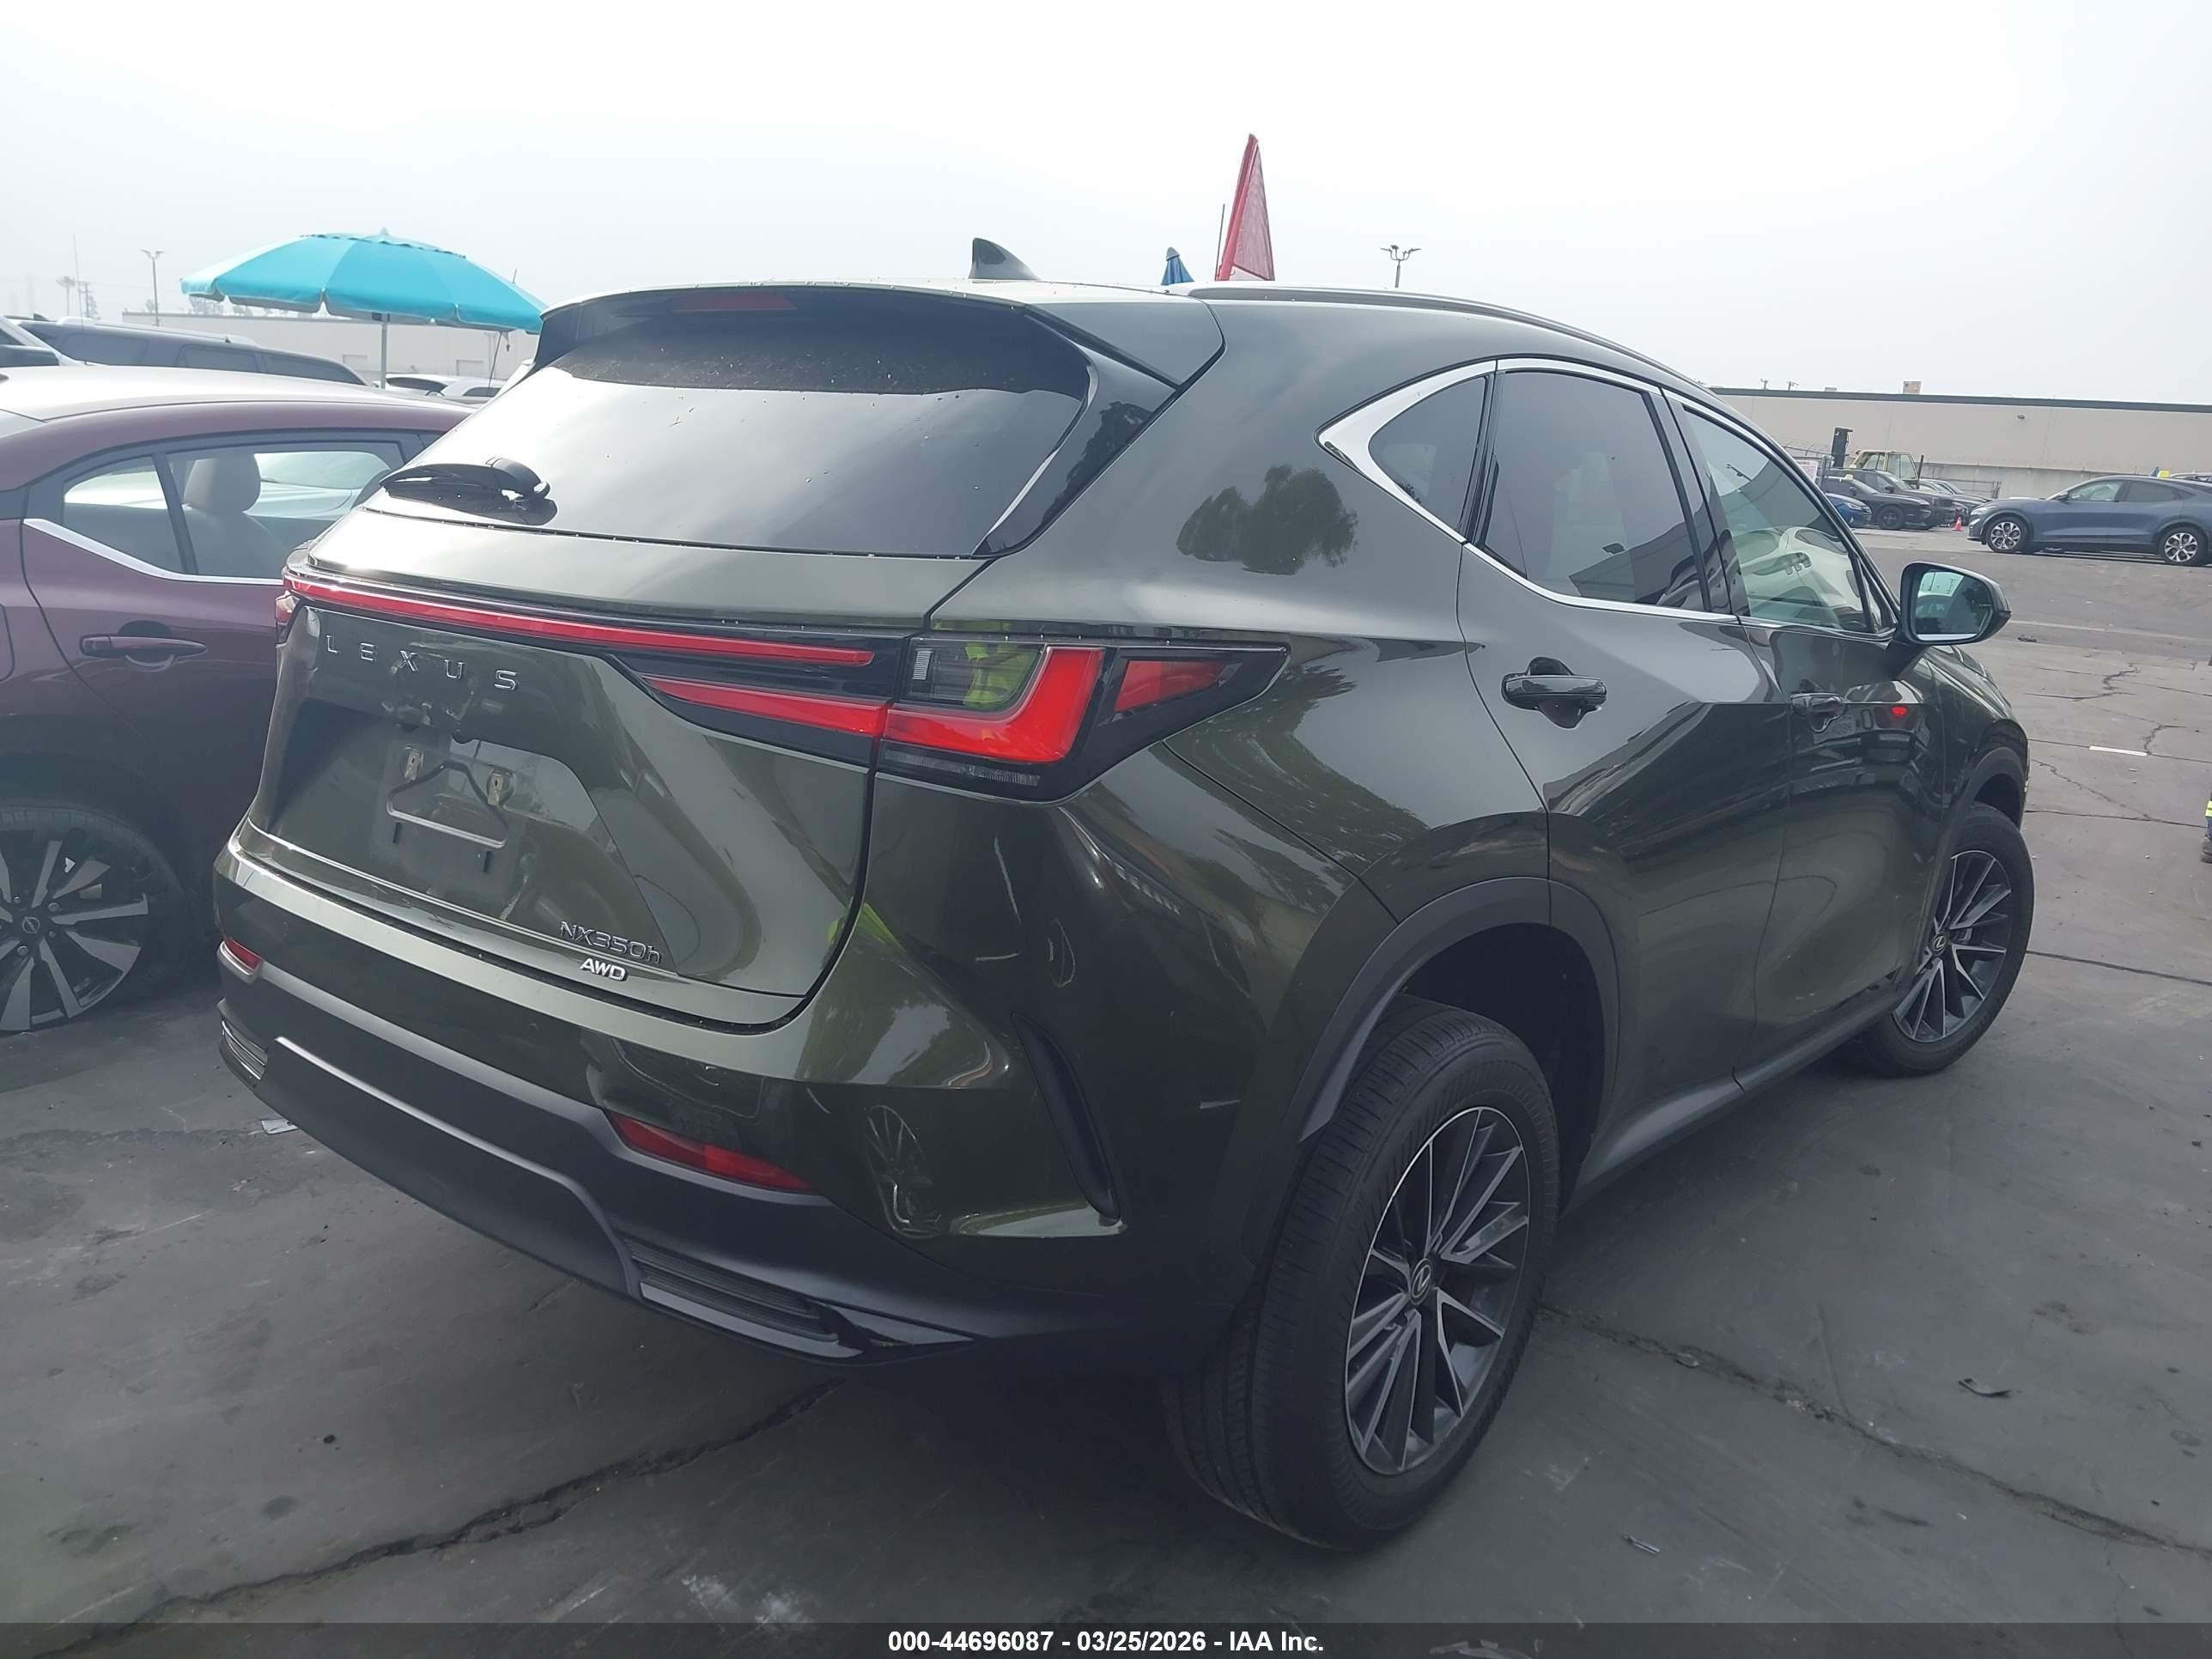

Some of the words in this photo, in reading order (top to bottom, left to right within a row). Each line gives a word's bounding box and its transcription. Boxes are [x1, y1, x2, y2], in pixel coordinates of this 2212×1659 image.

[326, 635, 519, 690] LEXUS
[560, 921, 660, 963] NX350h
[580, 957, 627, 981] AWD
